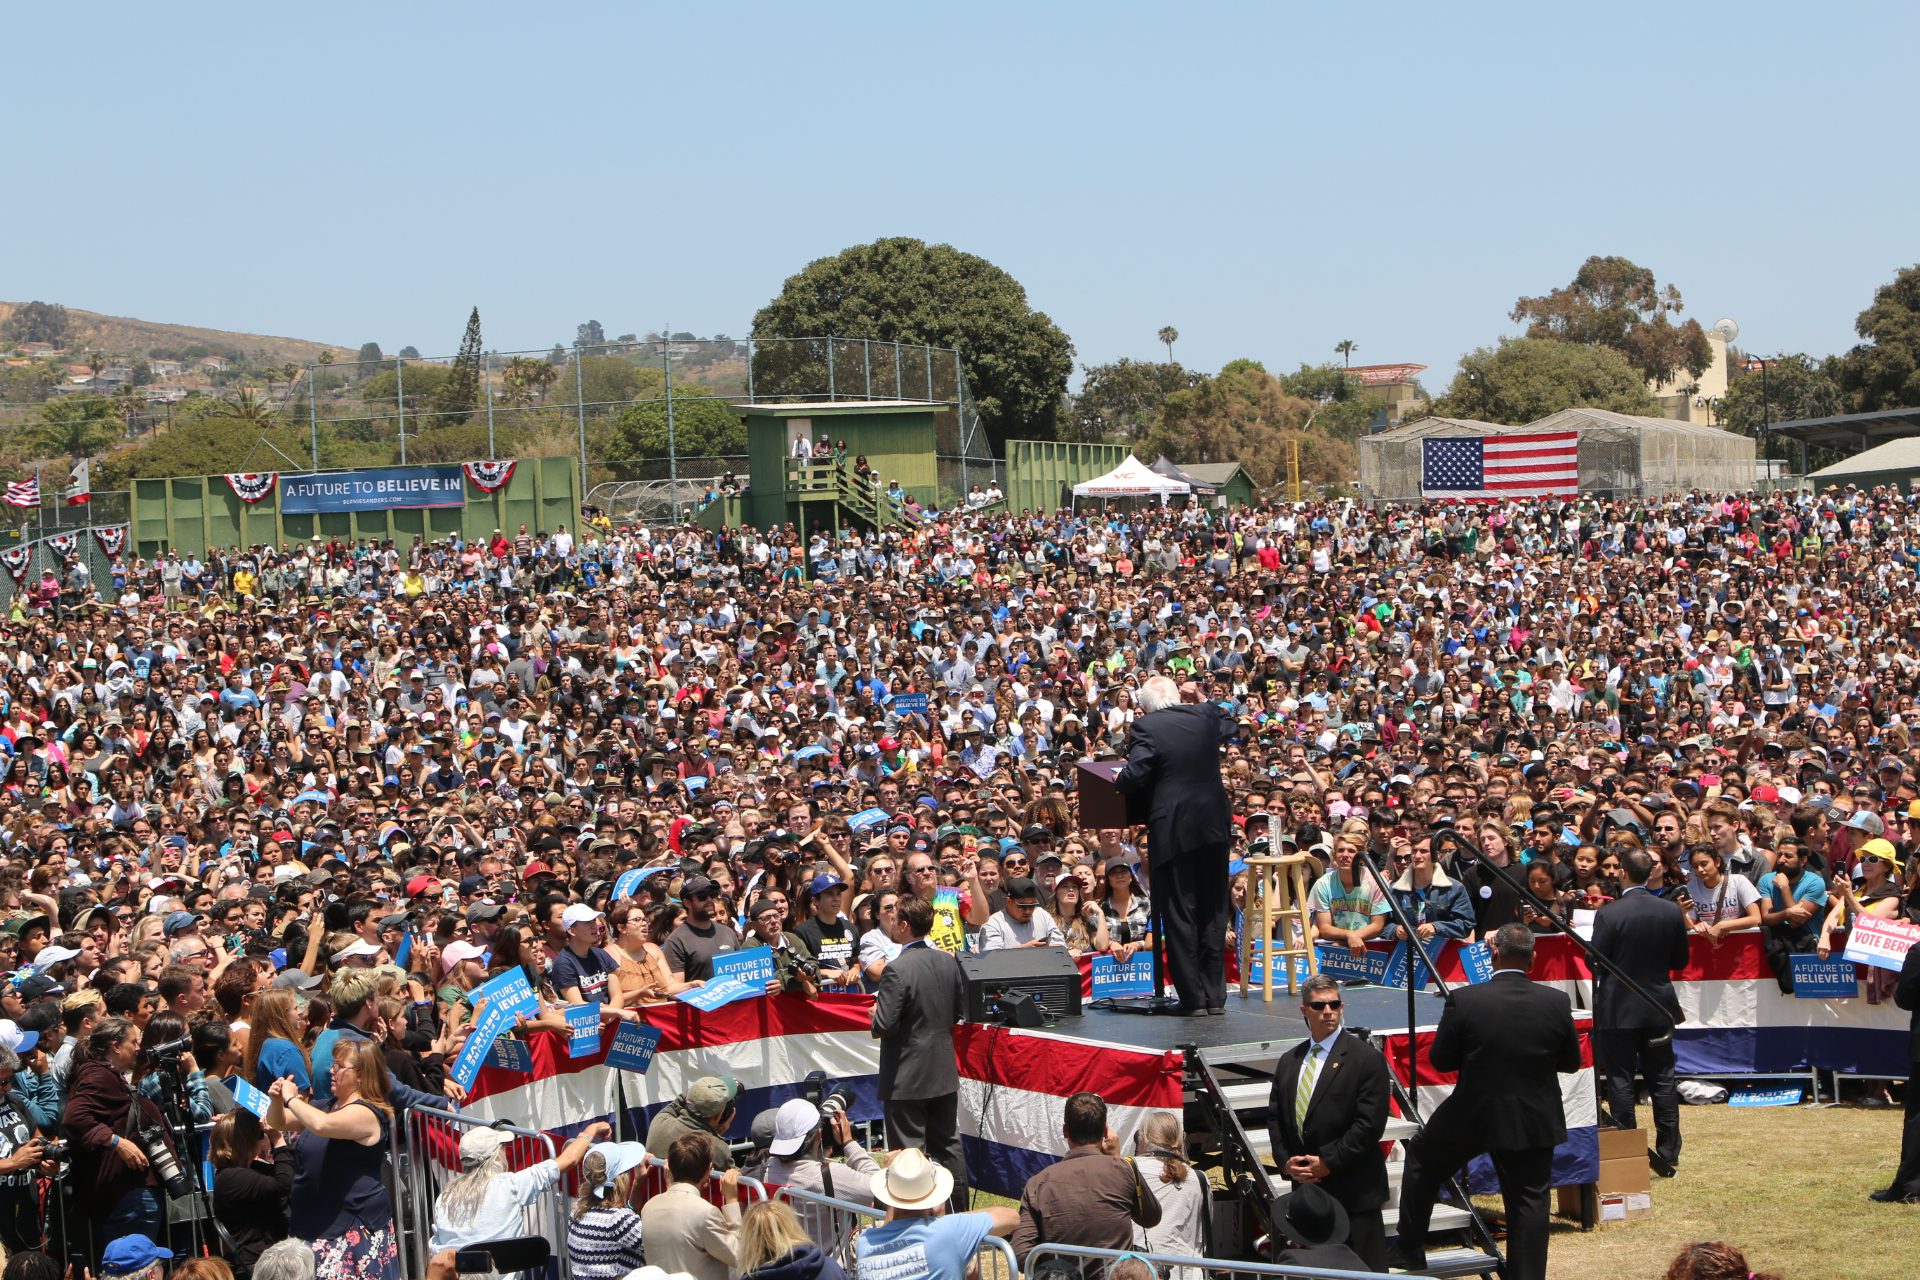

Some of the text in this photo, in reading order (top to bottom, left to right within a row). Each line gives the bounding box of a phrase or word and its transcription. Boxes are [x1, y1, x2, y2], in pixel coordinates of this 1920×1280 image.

[286, 478, 461, 497] A FUTURE TO BELIEVE IN
[1859, 916, 1874, 928] End
[1876, 920, 1910, 936] Student
[1855, 931, 1880, 948] VOTE
[1469, 946, 1480, 960] TO
[1478, 943, 1489, 956] IN
[717, 957, 771, 975] A FUTURE TO
[1329, 952, 1368, 964] FUTURE
[1371, 958, 1384, 967] TO
[762, 968, 773, 978] IN
[1094, 966, 1101, 974] A
[1102, 963, 1136, 973] FUTURE
[1321, 960, 1383, 975] BELIEVE IN
[1803, 964, 1837, 972] FUTURE
[1839, 964, 1853, 972] TO
[1094, 972, 1151, 985] BELIEVE IN
[1795, 974, 1854, 983] BELIEVE IN
[486, 978, 527, 1002] UTURE TO
[498, 988, 532, 1011] IEVE IN
[574, 1015, 594, 1026] FUTURE
[457, 1008, 499, 1080] BELIEVE IN
[470, 1022, 496, 1068] FUTURE
[622, 1032, 646, 1046] FUTURE
[646, 1038, 656, 1048] TO
[612, 1041, 653, 1059] BELIEVE IN
[462, 1069, 473, 1084] TO
[1750, 1088, 1799, 1097] BELIEVE
[246, 1101, 256, 1109] A
[889, 1239, 912, 1249] THE
[857, 1251, 927, 1274] POLITICAL
